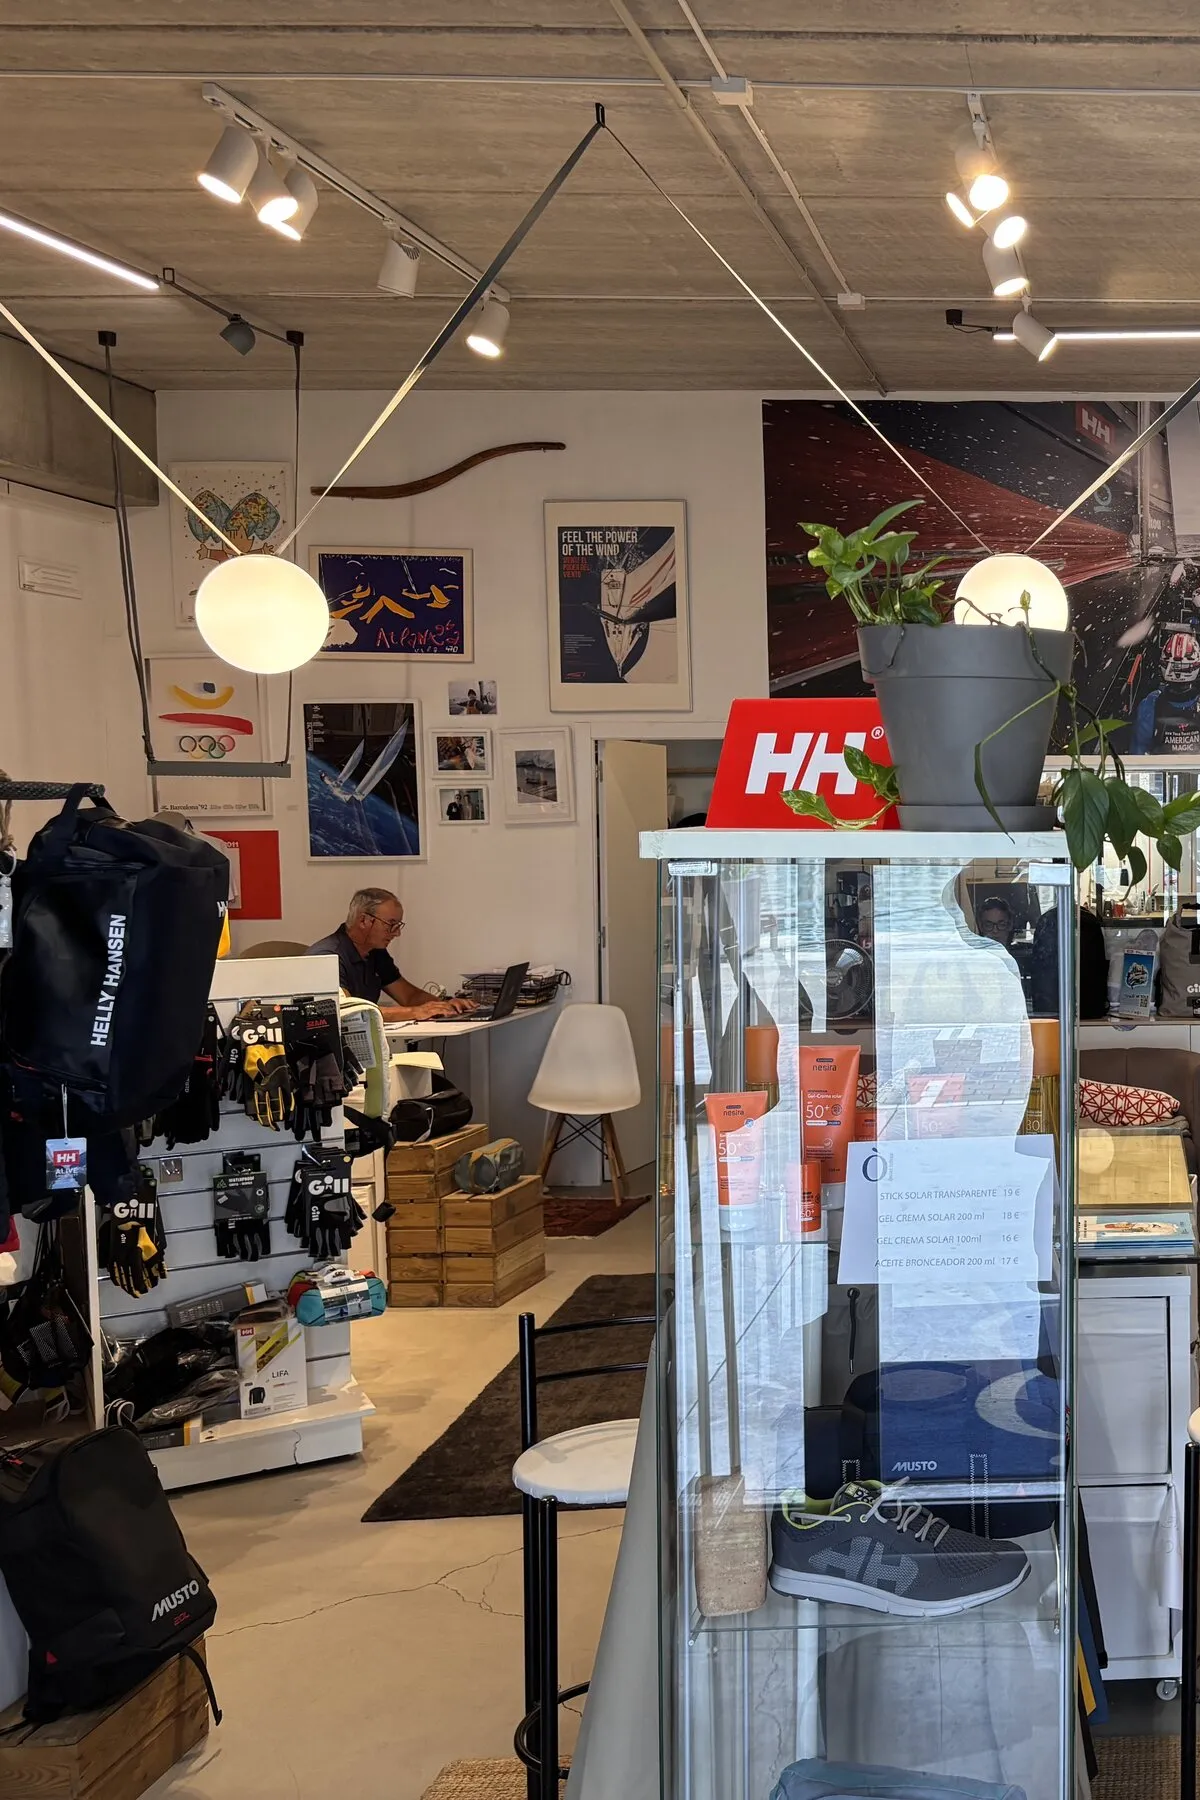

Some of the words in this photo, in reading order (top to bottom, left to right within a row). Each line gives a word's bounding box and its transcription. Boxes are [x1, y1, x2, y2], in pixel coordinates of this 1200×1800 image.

[1082, 408, 1110, 444] HH
[562, 531, 584, 543] FEEL
[586, 531, 604, 543] THE
[606, 531, 638, 543] POWER
[562, 544, 574, 556] OF
[576, 544, 594, 556] THE
[595, 544, 620, 556] WIND
[1164, 735, 1199, 744] AMERICAN
[745, 732, 866, 794] HH
[103, 914, 126, 987] HANSEN
[91, 990, 116, 1046] HELLY
[242, 1025, 283, 1044] Gill
[229, 1048, 239, 1064] Gill
[812, 1063, 837, 1072] nesira
[723, 1109, 745, 1117] nesira
[56, 1153, 76, 1163] HH
[308, 1175, 349, 1196] Gill
[880, 1192, 903, 1200] STICK
[905, 1191, 932, 1200] SOLAR
[934, 1189, 997, 1199] TRANSPARENTE
[1003, 1188, 1013, 1197] 19
[113, 1199, 154, 1219] Gill
[311, 1205, 321, 1222] Gill
[879, 1214, 894, 1223] GEL
[896, 1213, 925, 1222] CREMA
[927, 1213, 956, 1222] SOLAR
[957, 1213, 973, 1221] 200
[974, 1212, 985, 1220] ml
[1002, 1211, 1013, 1220] 18
[877, 1237, 892, 1245] GEL
[895, 1236, 924, 1245] CREMA
[927, 1235, 954, 1244] SOLAR
[957, 1235, 982, 1243] 100ml
[1002, 1234, 1011, 1243] 16
[875, 1259, 904, 1267] ACEITE
[906, 1257, 966, 1267] BRONCEADOR
[967, 1257, 983, 1266] 200
[984, 1257, 996, 1266] ml
[1002, 1257, 1011, 1265] 17
[271, 1370, 289, 1379] LIFA
[891, 1460, 938, 1472] MUSTO
[151, 1579, 200, 1622] MUSTO
